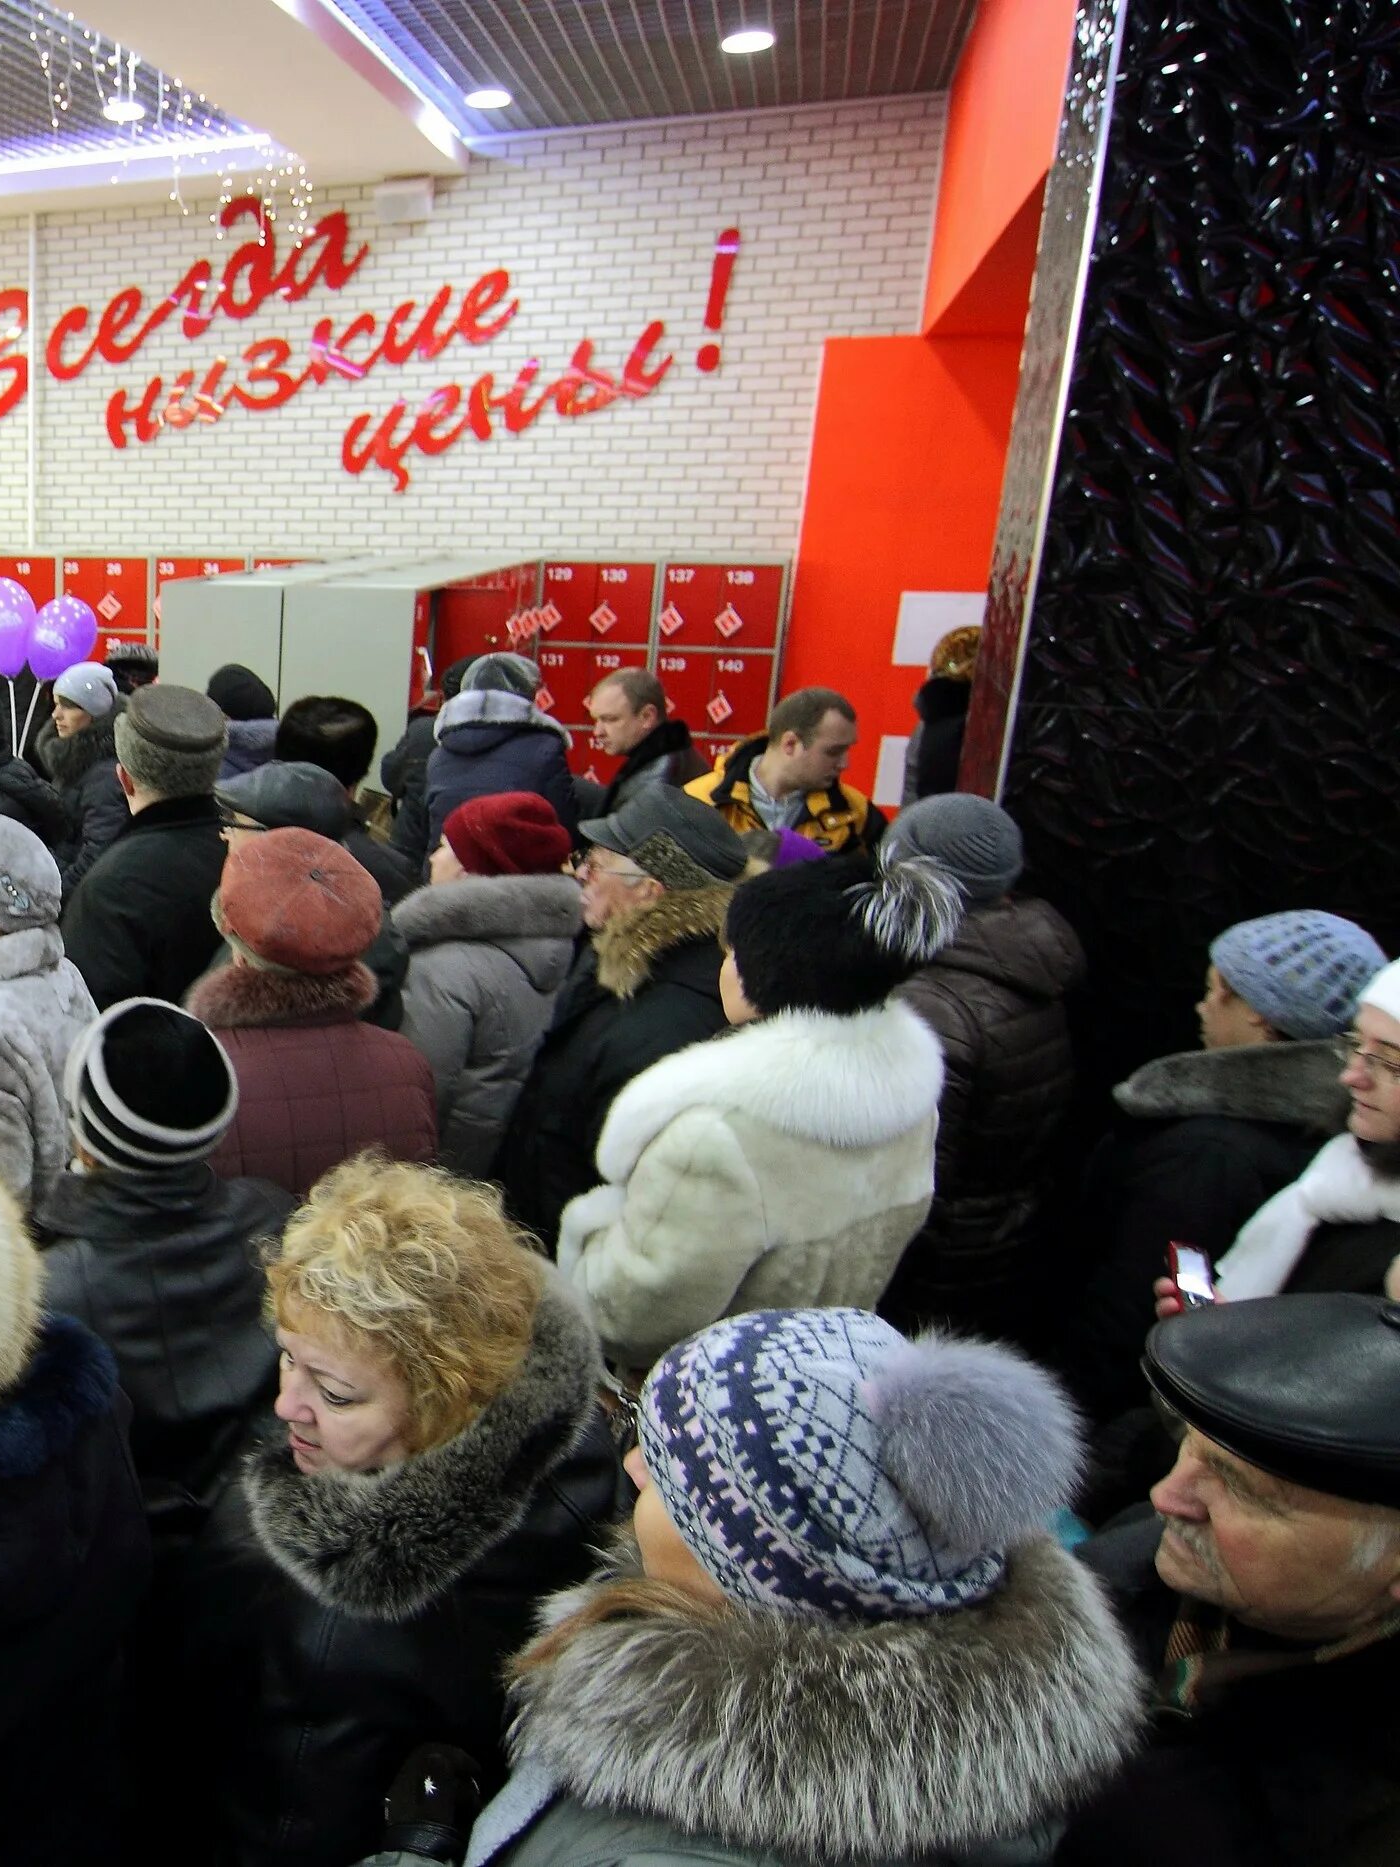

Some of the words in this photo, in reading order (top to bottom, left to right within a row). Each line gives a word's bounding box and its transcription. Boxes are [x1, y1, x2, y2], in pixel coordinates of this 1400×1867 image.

[104, 268, 521, 450] низкие
[341, 228, 741, 493] цены!
[668, 569, 695, 583] 137
[541, 653, 565, 667] 131
[596, 654, 621, 668] 132
[717, 659, 745, 673] 140
